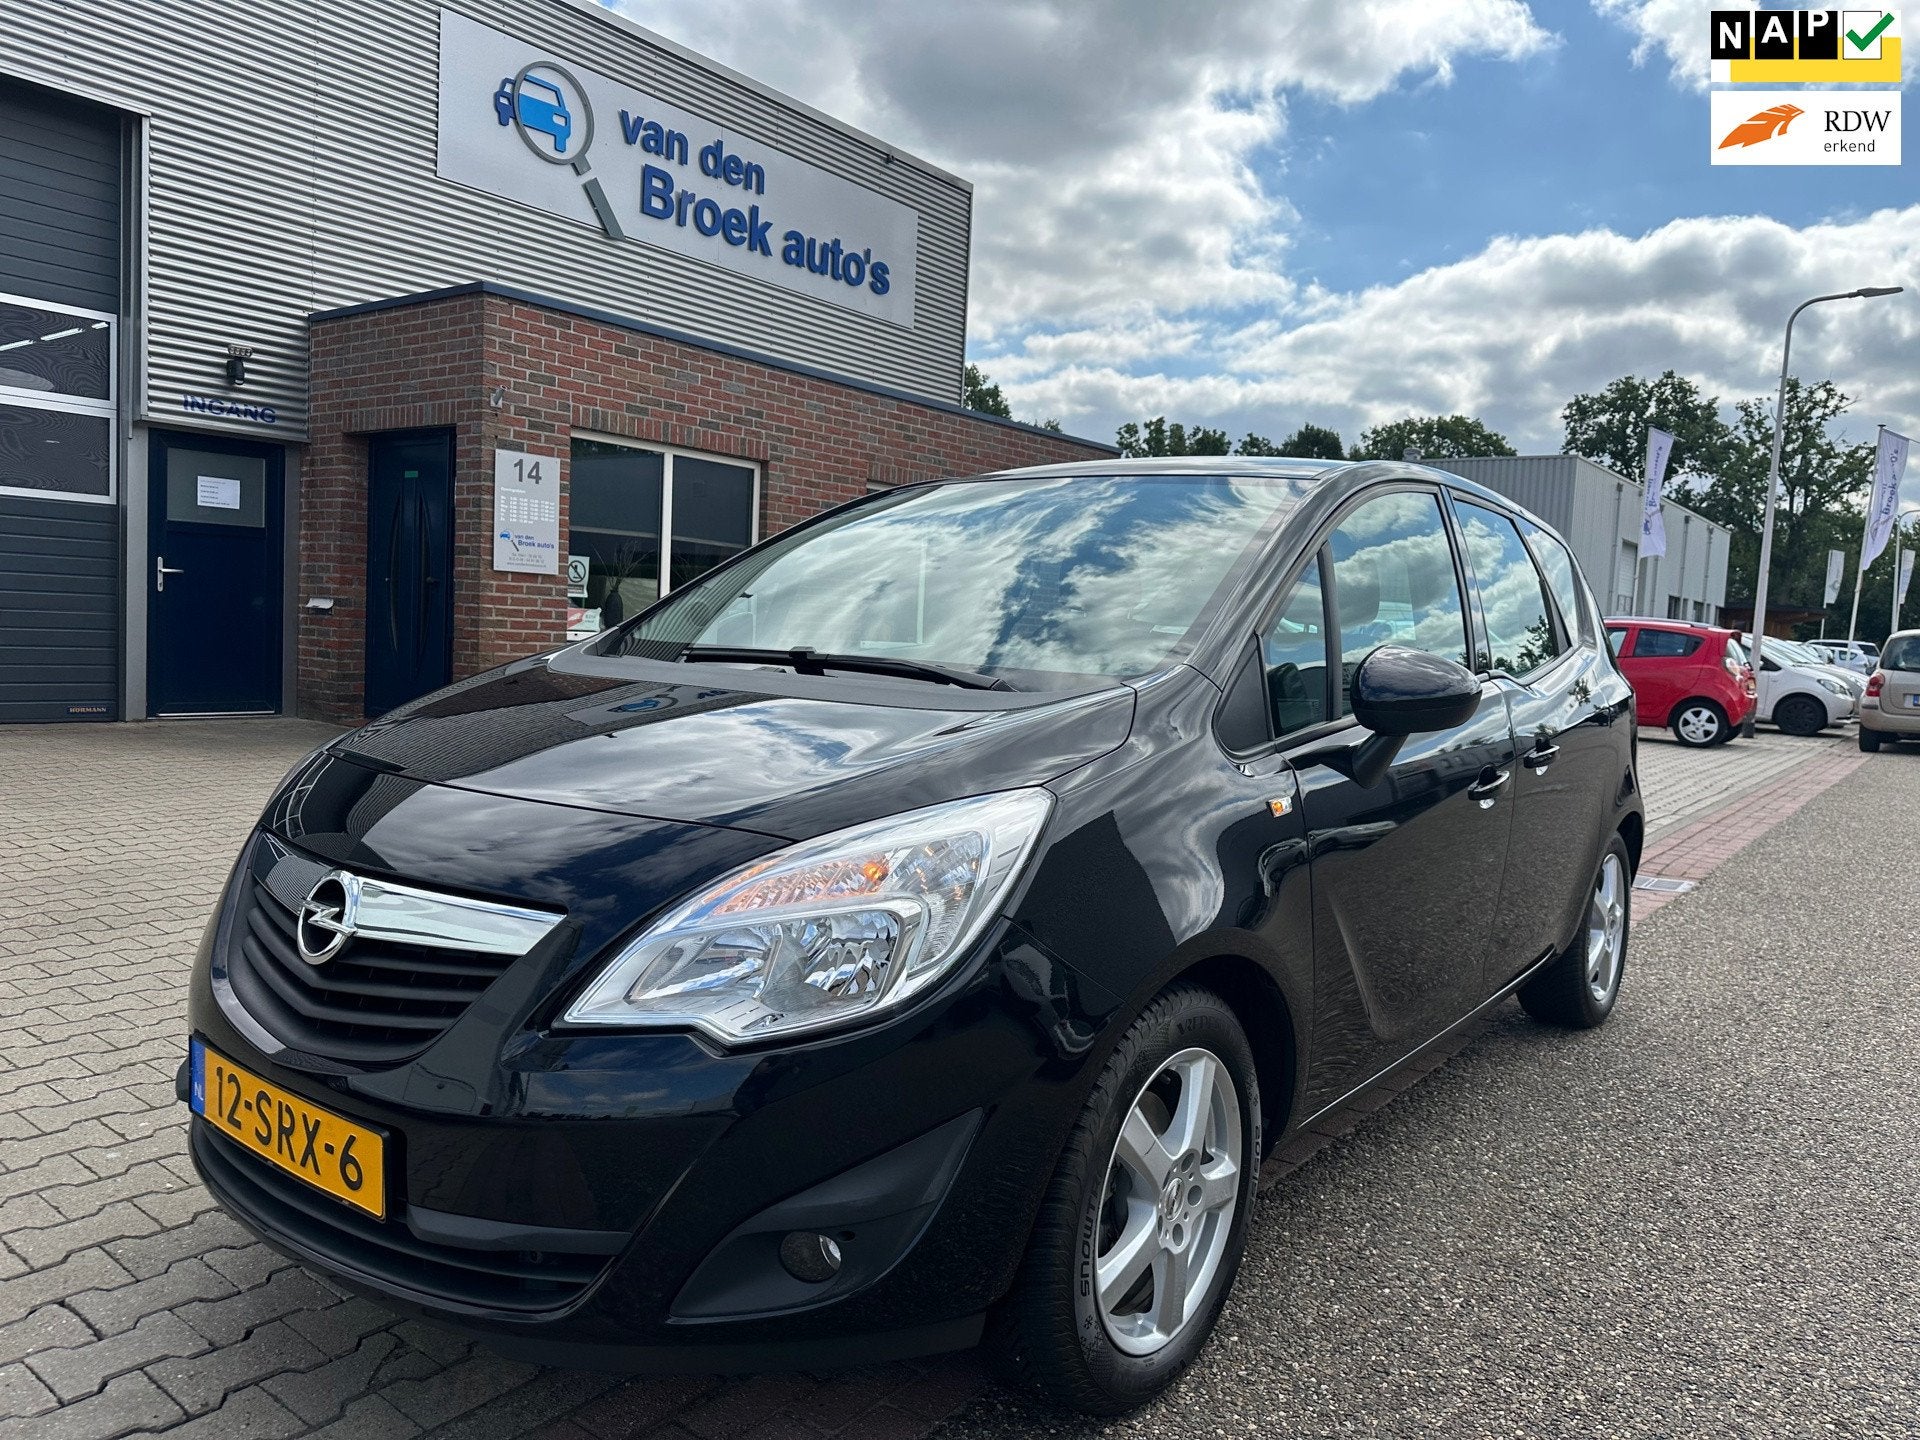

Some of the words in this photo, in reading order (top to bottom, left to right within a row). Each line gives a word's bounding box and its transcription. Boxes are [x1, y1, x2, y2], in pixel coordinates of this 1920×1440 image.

[619, 109, 689, 166] van
[700, 139, 765, 195] den
[640, 164, 773, 257] Broek
[782, 230, 890, 295] auto's
[182, 393, 276, 424] INGANG
[513, 458, 542, 485] 14
[517, 539, 536, 548] Broek
[216, 1065, 364, 1192] 12-SRX-6
